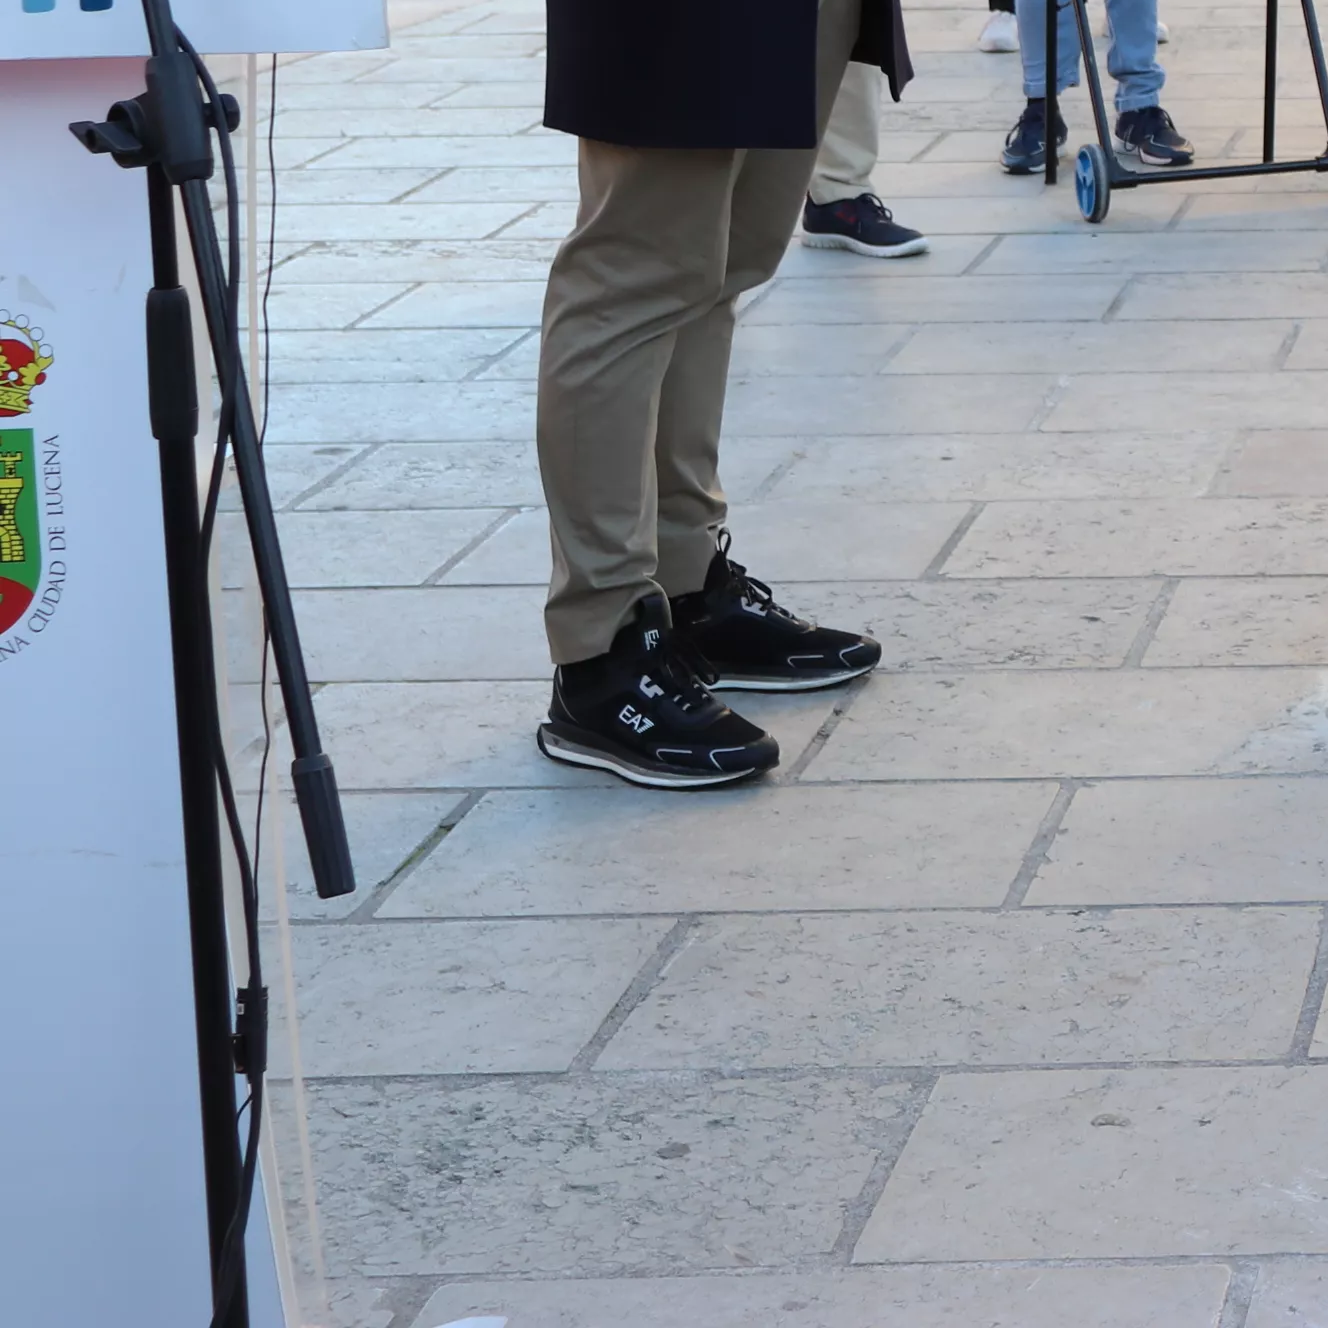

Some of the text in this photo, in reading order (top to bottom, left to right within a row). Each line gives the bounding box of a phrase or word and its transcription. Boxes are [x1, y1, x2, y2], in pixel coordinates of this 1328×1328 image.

[42, 434, 64, 516] LUCENA
[48, 526, 66, 551] DE
[28, 560, 67, 633] CIUDAD
[619, 704, 655, 734] EA7
